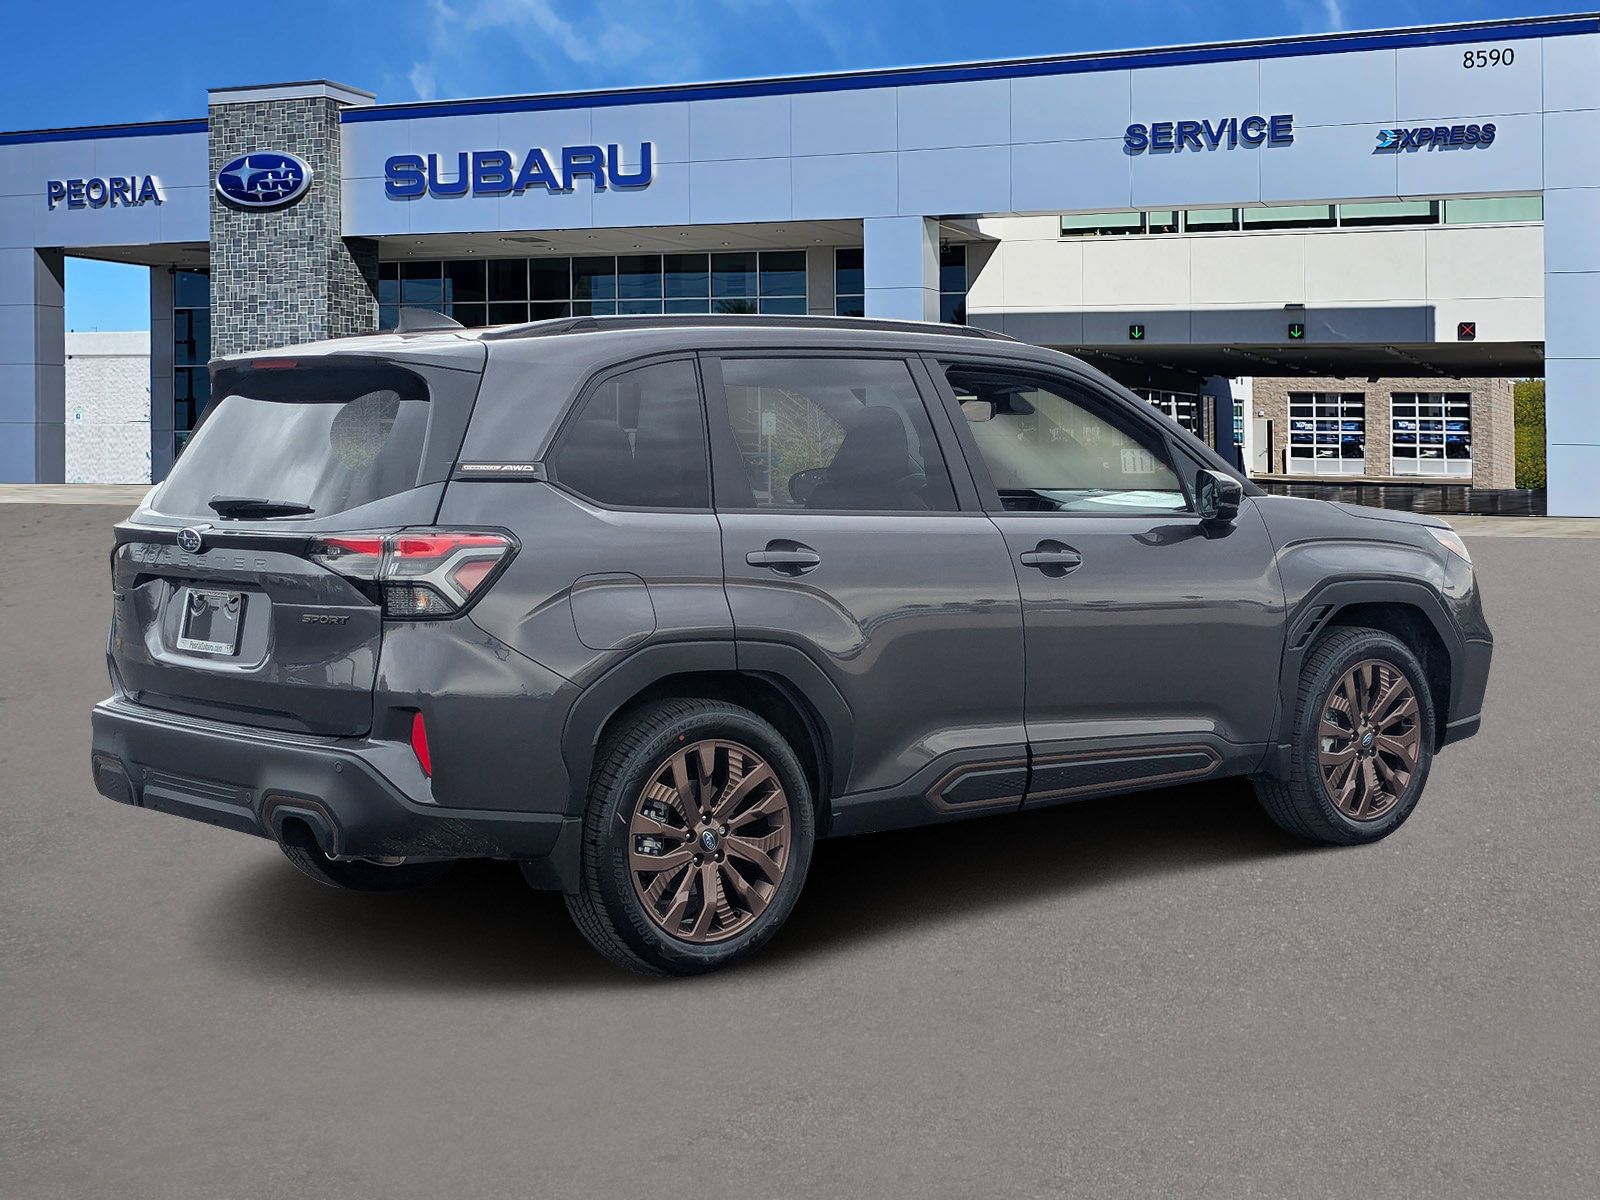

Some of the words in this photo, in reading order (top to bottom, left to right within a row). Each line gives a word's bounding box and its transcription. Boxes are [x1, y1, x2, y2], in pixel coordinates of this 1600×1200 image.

[1463, 48, 1515, 69] 8590
[1125, 114, 1294, 151] SERVICE
[1373, 124, 1496, 151] EXPRESS
[384, 141, 653, 197] SUBARU
[47, 174, 163, 208] PEORIA
[302, 614, 350, 625] SPORT
